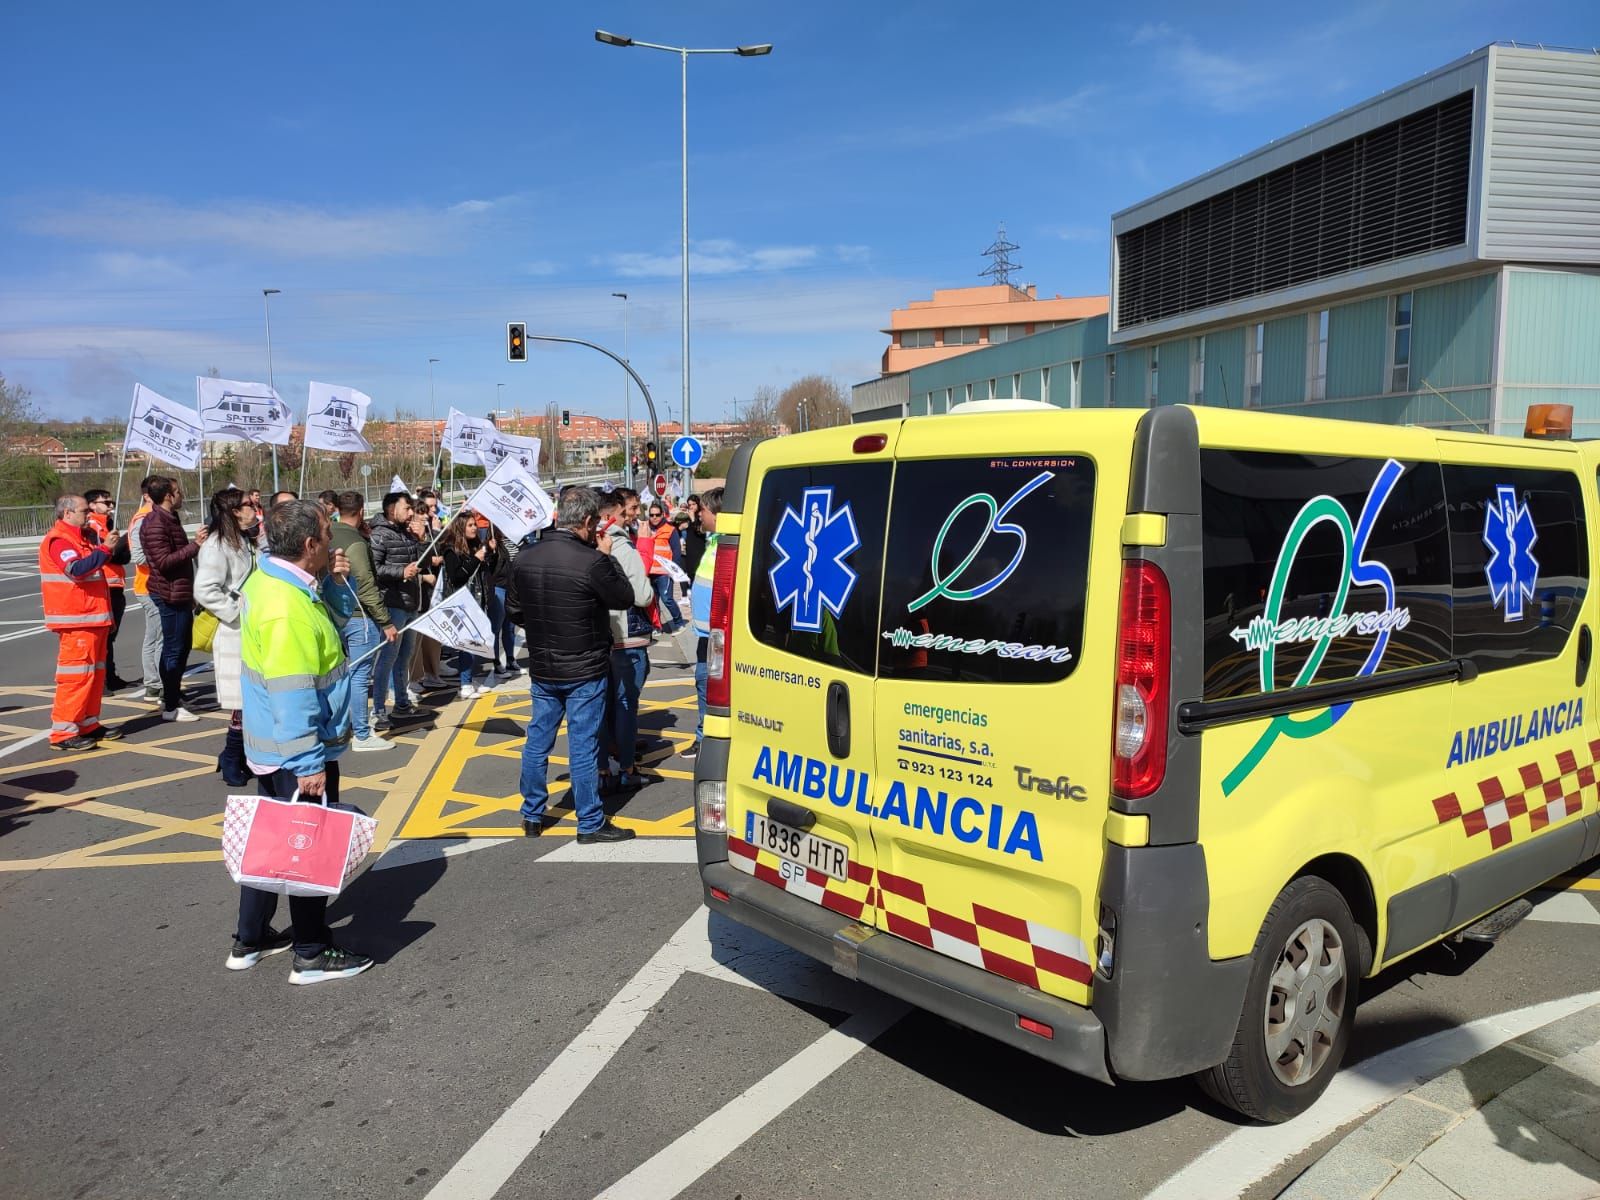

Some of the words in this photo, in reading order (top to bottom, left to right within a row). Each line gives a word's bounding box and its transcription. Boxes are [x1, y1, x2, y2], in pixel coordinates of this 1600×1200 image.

[226, 413, 265, 424] SP-TES
[149, 428, 182, 451] SP-TES
[1012, 460, 1076, 468] CONVERSION
[500, 495, 522, 513] SP-TES
[1272, 606, 1412, 644] emersan
[912, 633, 1073, 664] emersan
[734, 661, 821, 689] www.emersan.es
[738, 710, 784, 734] RENAULT
[903, 702, 988, 727] emergencias
[899, 728, 966, 755] sanitarias,
[969, 741, 995, 757] s.a.
[1446, 697, 1583, 769] AMBULANCIA
[911, 761, 935, 776] 923
[939, 767, 963, 782] 123
[968, 773, 994, 788] 124
[1013, 764, 1089, 803] Trafic
[752, 745, 1044, 862] AMBULANCIA
[760, 820, 801, 858] 1836
[808, 838, 845, 877] HTR
[781, 861, 804, 882] SP
